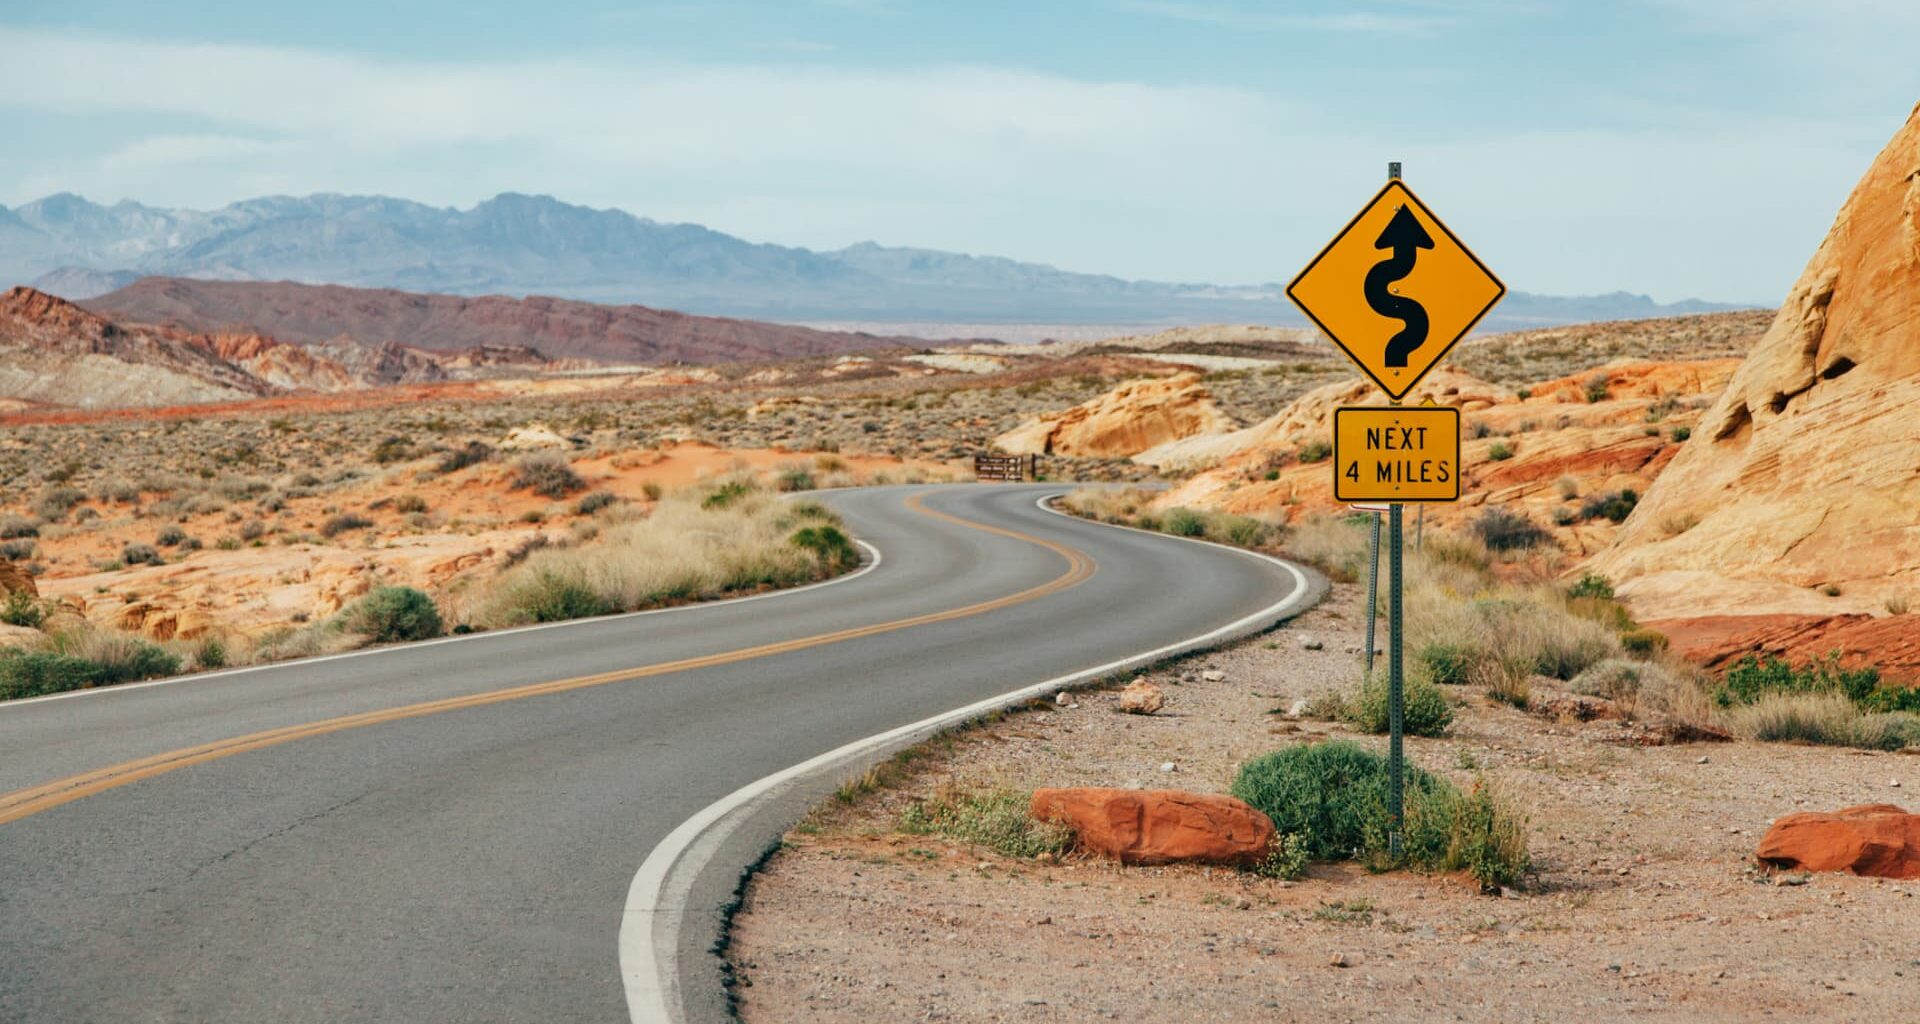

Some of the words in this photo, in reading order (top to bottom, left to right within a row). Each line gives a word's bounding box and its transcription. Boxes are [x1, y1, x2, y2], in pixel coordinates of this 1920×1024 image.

[1367, 427, 1428, 450] NEXT
[1345, 460, 1360, 483] 4
[1376, 460, 1450, 483] MILES
